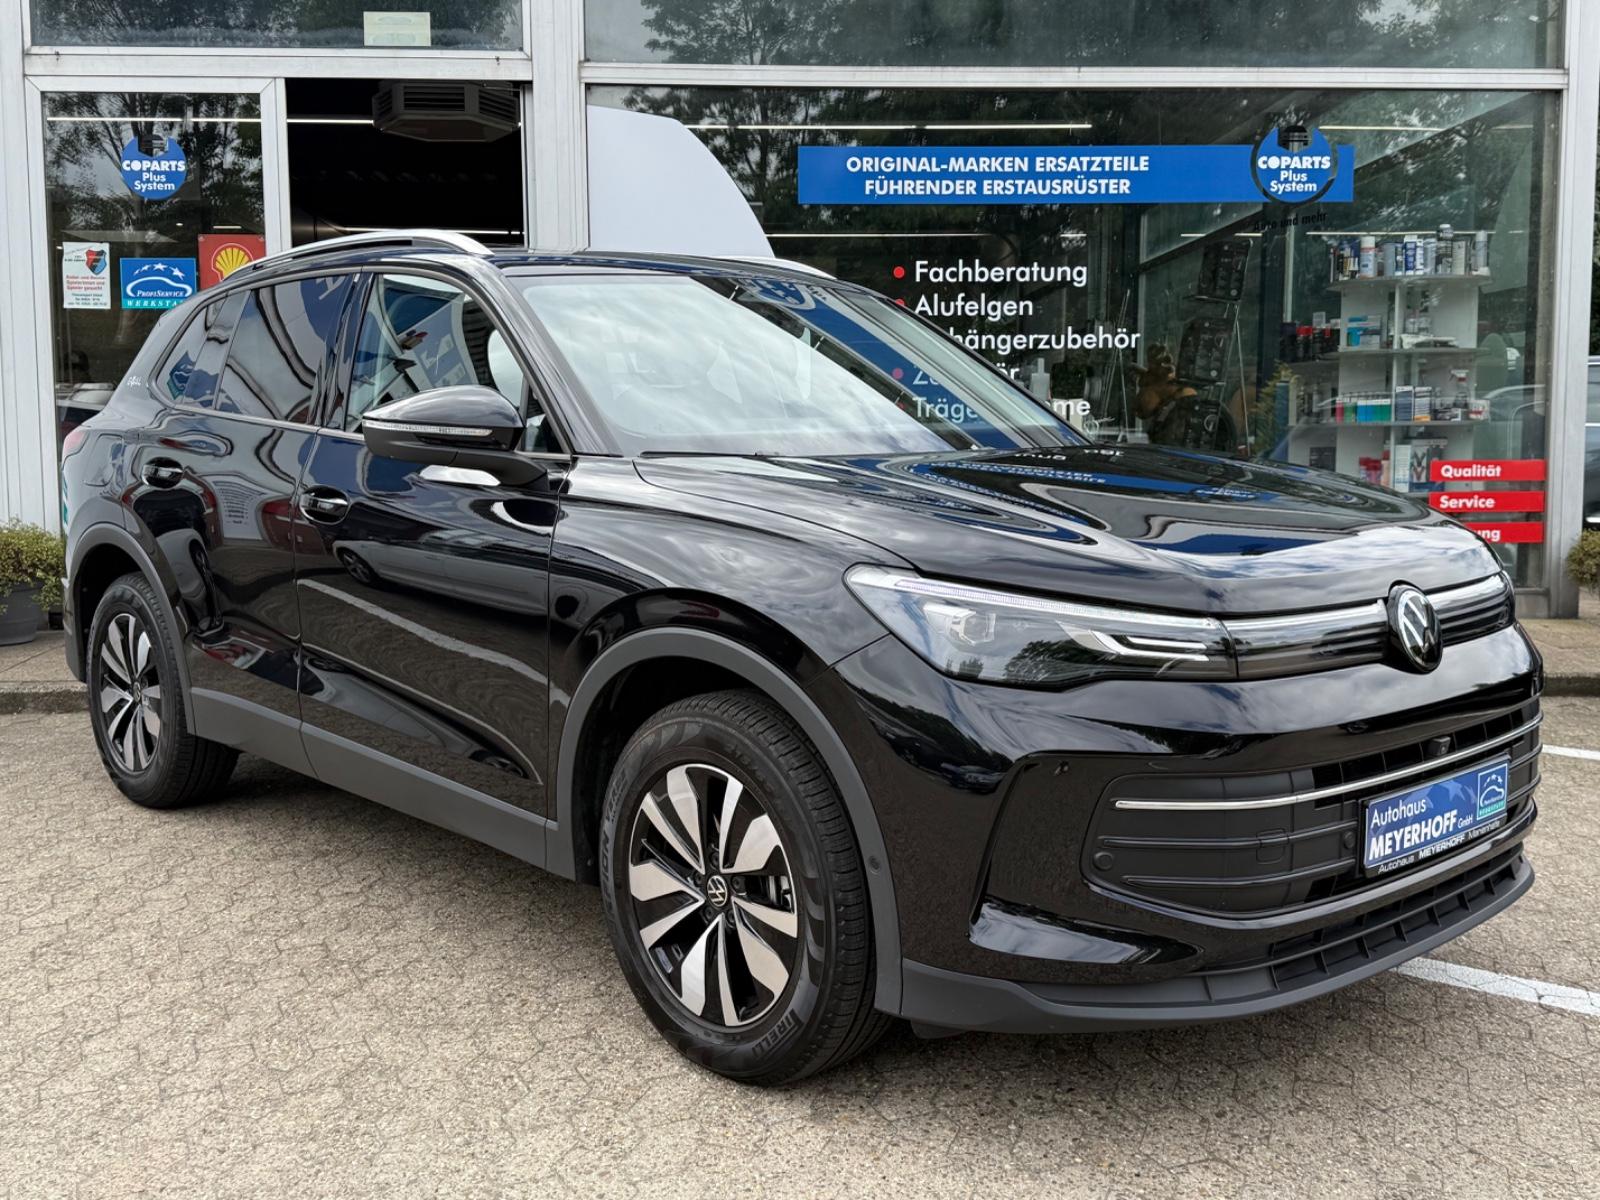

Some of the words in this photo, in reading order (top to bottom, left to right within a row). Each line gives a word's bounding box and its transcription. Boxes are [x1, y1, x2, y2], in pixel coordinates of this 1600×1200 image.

[122, 160, 186, 171] COPARTS
[846, 156, 1029, 173] ORIGINAL-MARKEN
[1035, 156, 1150, 172] ERSATZTEILE
[1257, 155, 1331, 169] COPARTS
[142, 172, 167, 182] Plus
[1280, 170, 1308, 182] Plus
[133, 181, 176, 192] System
[865, 176, 978, 196] FÜHRENDER
[983, 175, 1131, 195] ERSTAUSRÜSTER
[1270, 180, 1318, 194] System
[1302, 209, 1327, 224] mehr
[915, 259, 1088, 287] Fachberatung
[914, 293, 1033, 322] Alufelgen
[949, 326, 1141, 355] hängerzubehör
[1440, 464, 1502, 478] Qualität
[1440, 495, 1496, 509] Service
[1370, 799, 1427, 829] Autohaus
[1369, 809, 1458, 861] MEYERHOFF
[1457, 813, 1474, 829] GmbH
[1378, 854, 1415, 874] Autohaus
[1418, 834, 1467, 859] MEYERHOFF
[752, 1008, 804, 1058] PIRELLI
